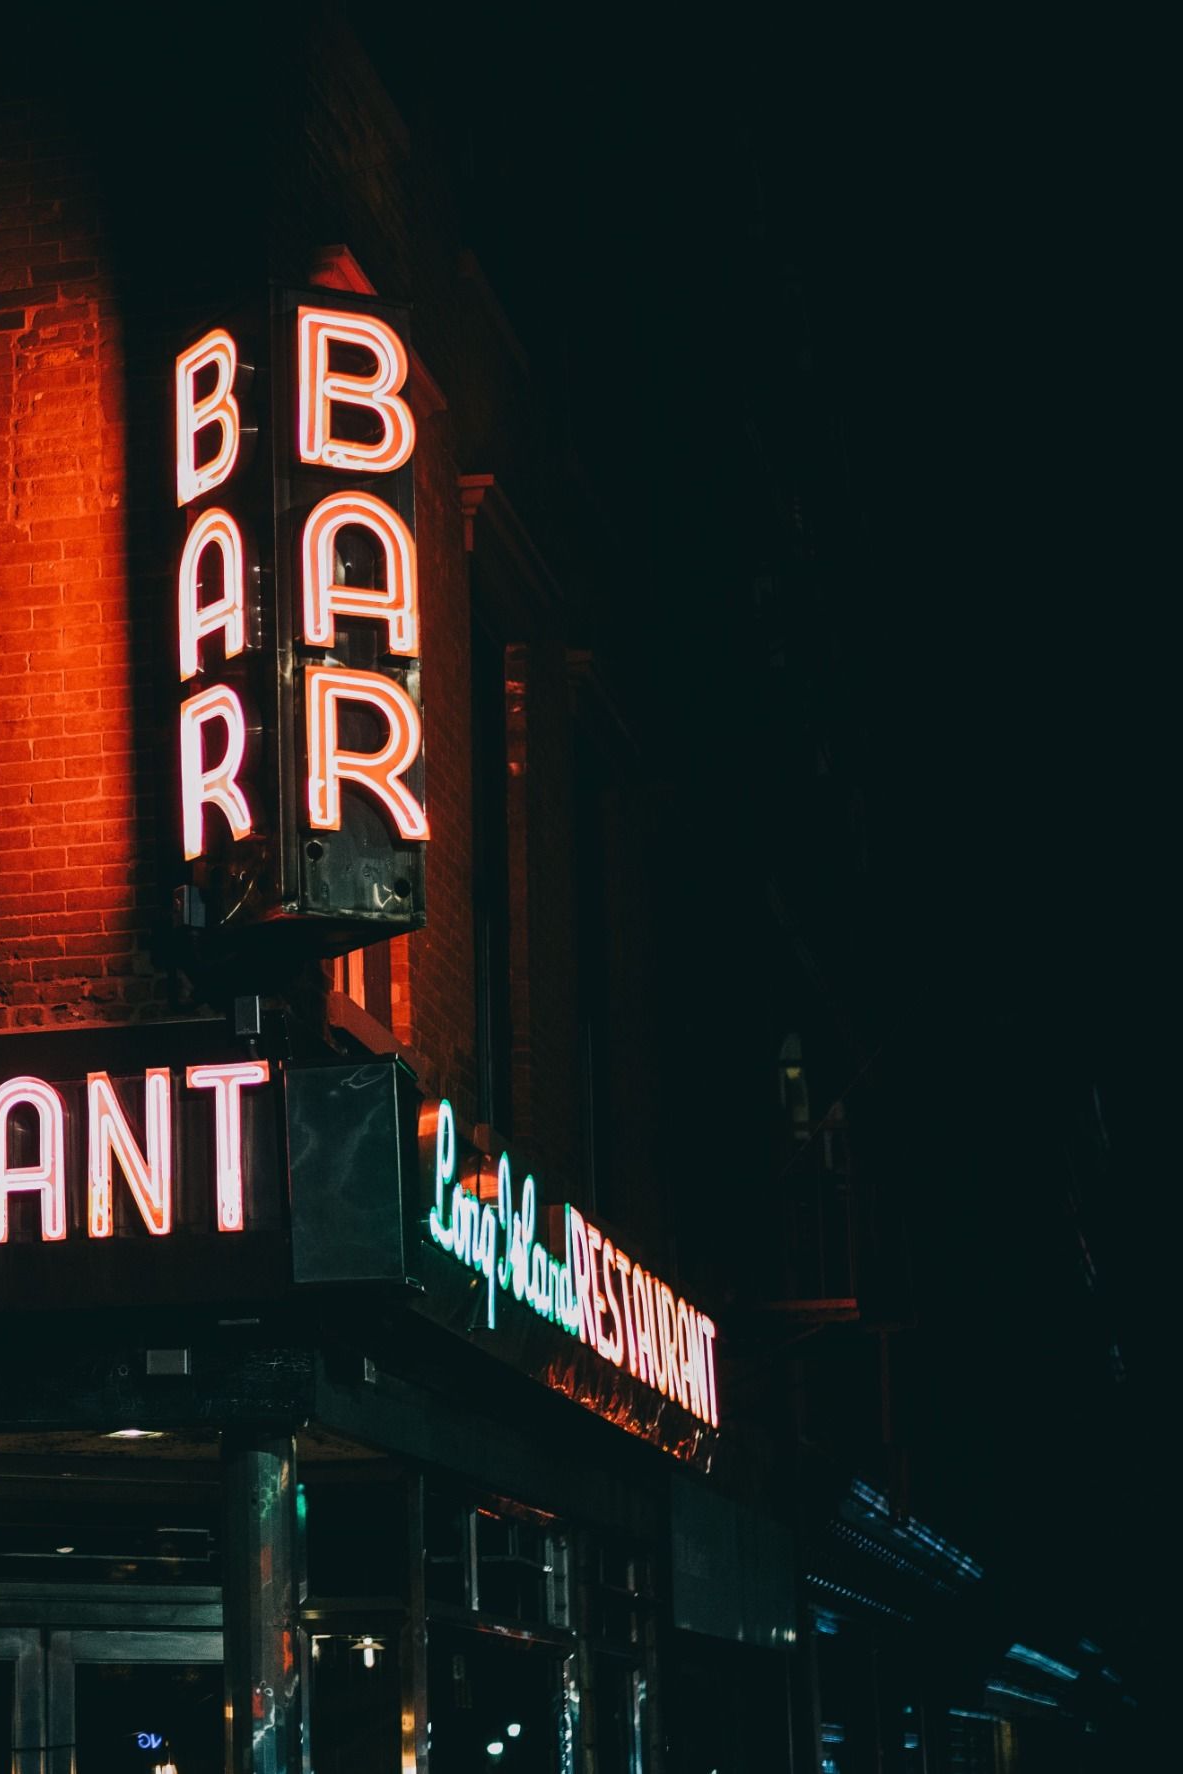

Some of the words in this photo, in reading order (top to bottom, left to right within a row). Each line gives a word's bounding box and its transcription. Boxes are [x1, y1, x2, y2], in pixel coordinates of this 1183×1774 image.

[176, 328, 251, 862] BAR
[298, 305, 430, 841] BAR
[430, 1097, 496, 1330] Long
[497, 1151, 580, 1337] Island
[569, 1204, 719, 1430] RESTAURANT
